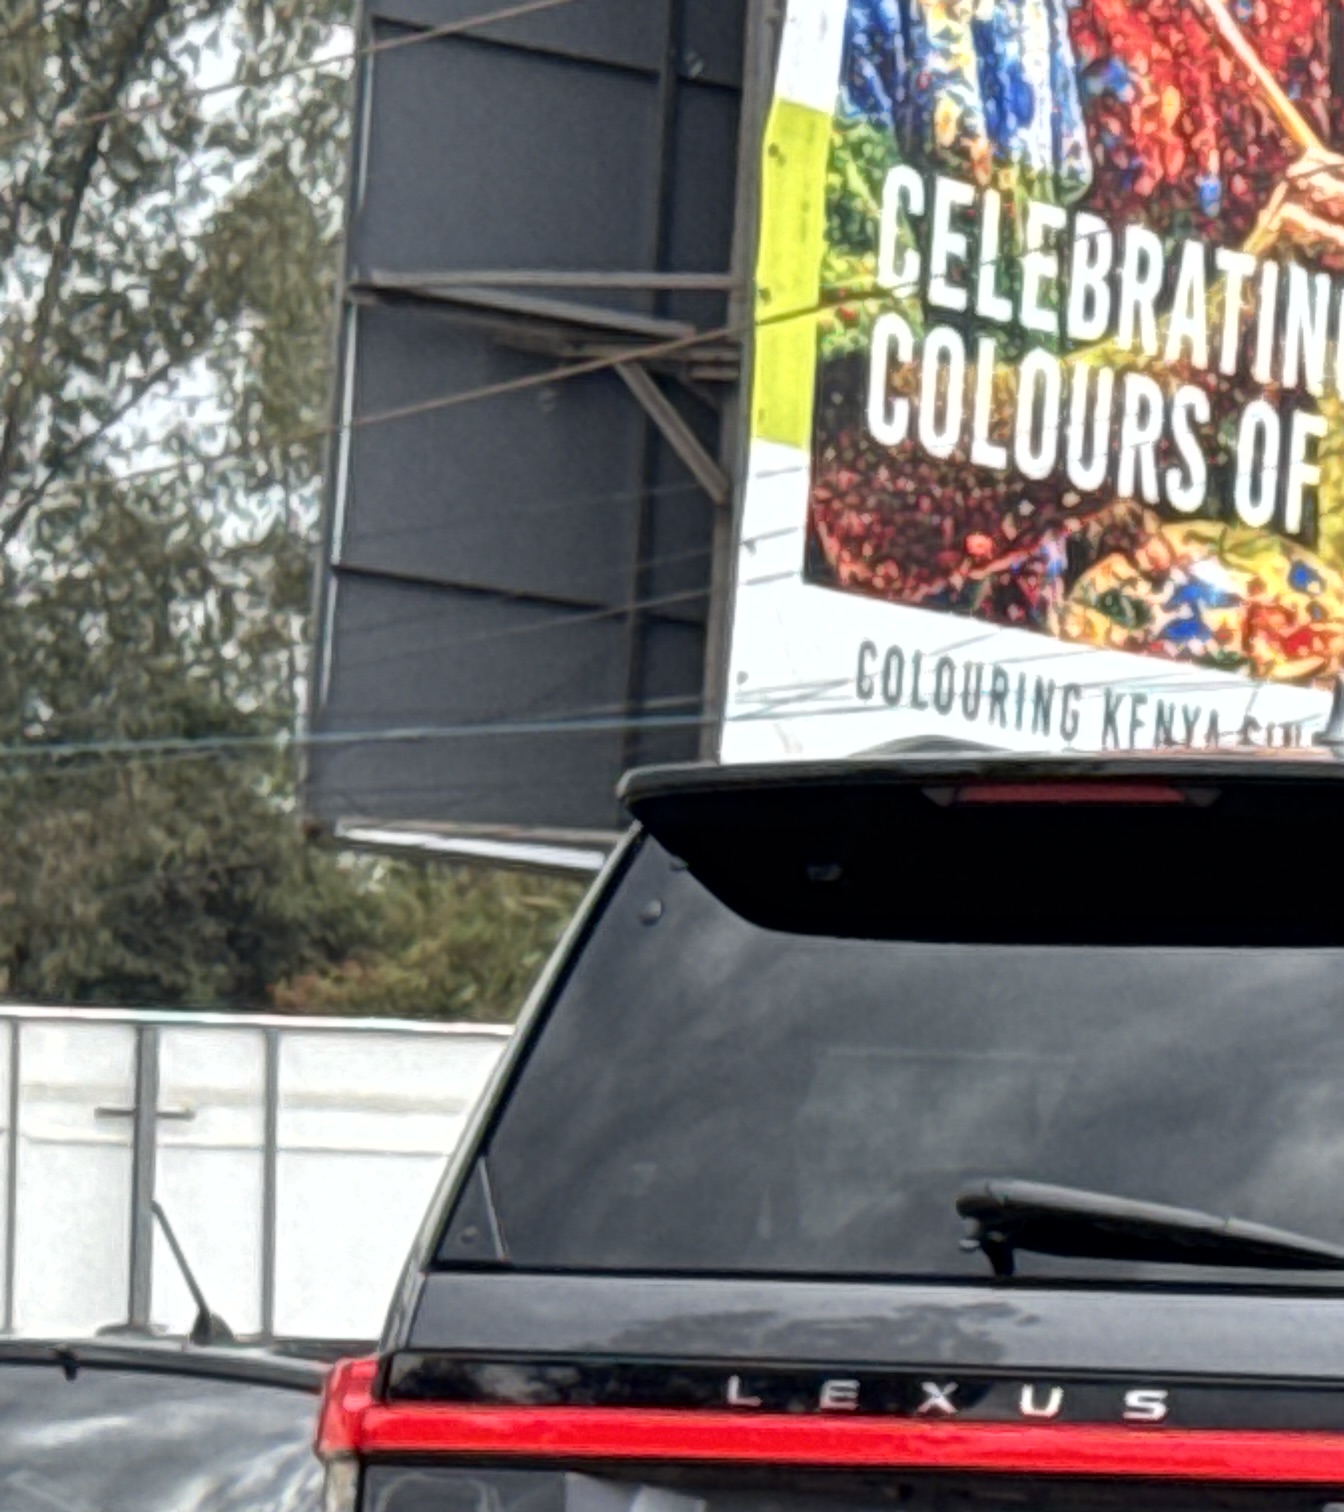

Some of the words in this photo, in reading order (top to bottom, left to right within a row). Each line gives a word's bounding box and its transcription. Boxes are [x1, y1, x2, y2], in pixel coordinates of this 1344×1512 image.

[867, 312, 1211, 514] COLOURS
[1233, 399, 1329, 534] OF
[855, 639, 1082, 741] COLOURING
[1101, 687, 1220, 750] KENYA
[727, 1375, 1168, 1421] LEXUS
